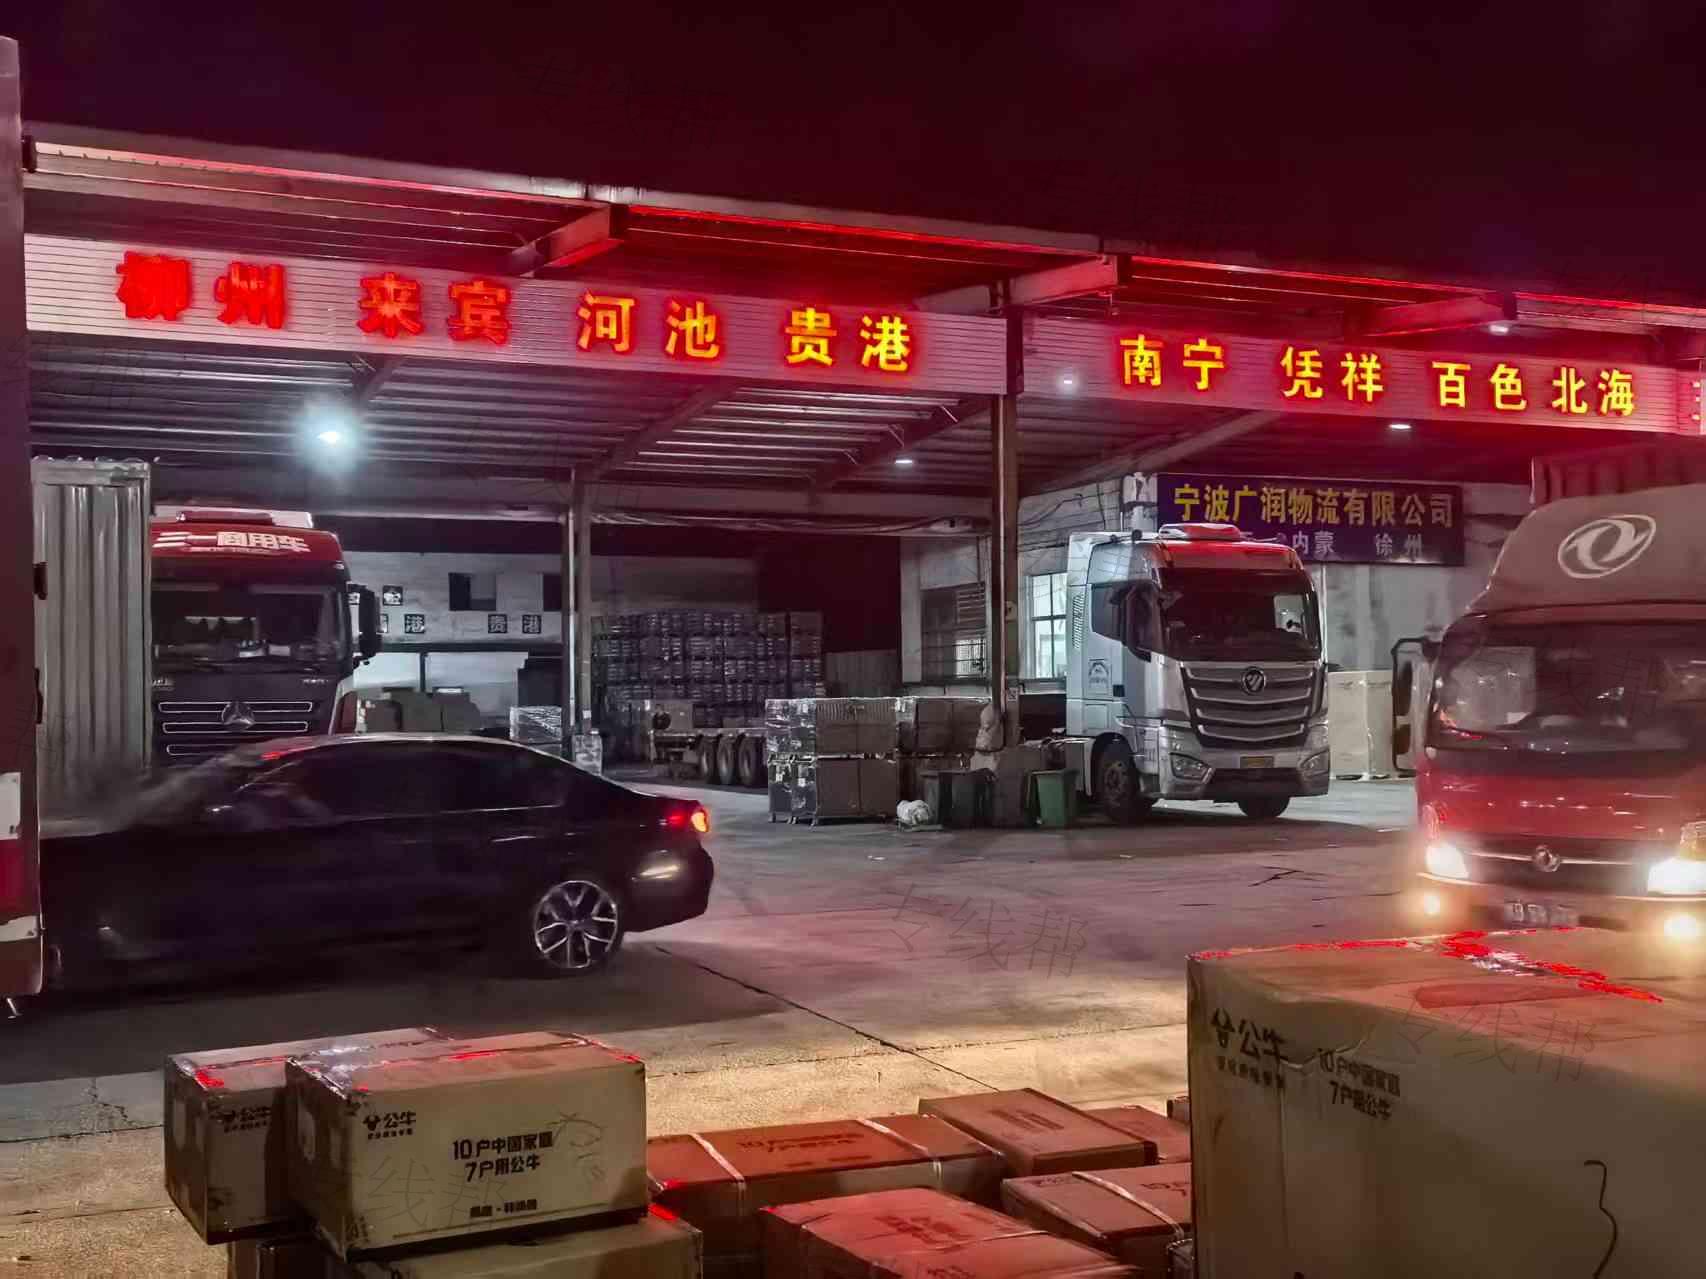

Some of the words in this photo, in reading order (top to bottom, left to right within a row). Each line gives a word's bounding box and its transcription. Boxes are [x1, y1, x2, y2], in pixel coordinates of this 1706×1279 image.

[357, 271, 512, 344] 来宾
[576, 287, 721, 360] 河池
[784, 306, 911, 372] 贵港
[1119, 333, 1226, 391] 南宁
[1280, 344, 1385, 403] 凭祥
[1173, 482, 1453, 528] 宁波广润物流有限公司
[383, 1110, 417, 1129] 公牛
